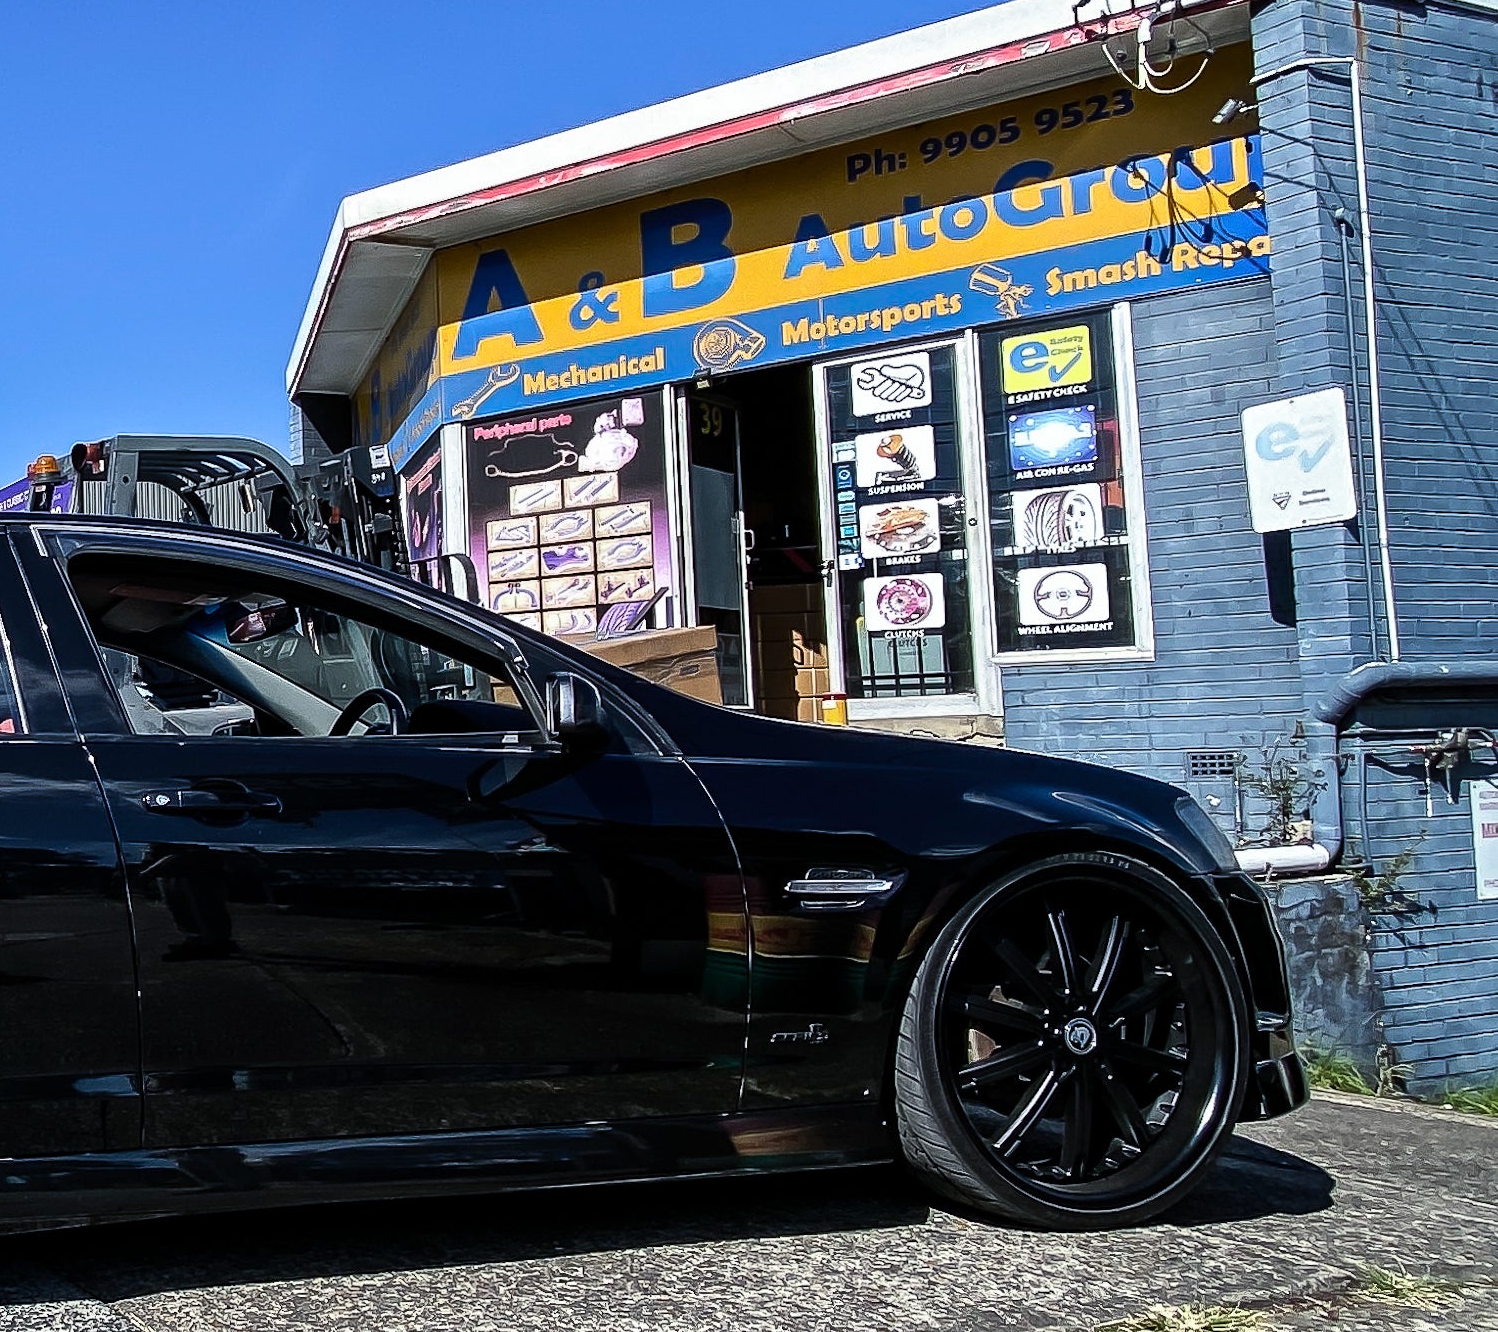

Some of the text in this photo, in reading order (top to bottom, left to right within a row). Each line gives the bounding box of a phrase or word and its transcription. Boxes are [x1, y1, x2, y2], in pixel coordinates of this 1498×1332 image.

[846, 89, 1135, 183] Ph: 9905 9523
[452, 135, 1262, 360] A & B AutoGrou
[522, 346, 665, 396] Mechanical
[782, 290, 963, 347] Motorsports
[1045, 249, 1163, 296] Smash
[1016, 387, 1053, 403] SAFETY
[1053, 384, 1088, 398] CHECK
[874, 410, 912, 423] SERVICE
[1016, 462, 1095, 480] AIR CON RE-GAS
[868, 482, 924, 496] SUSPENSION
[885, 555, 922, 566] BRAKES
[1018, 622, 1114, 636] WHEEL ALIGNMENT
